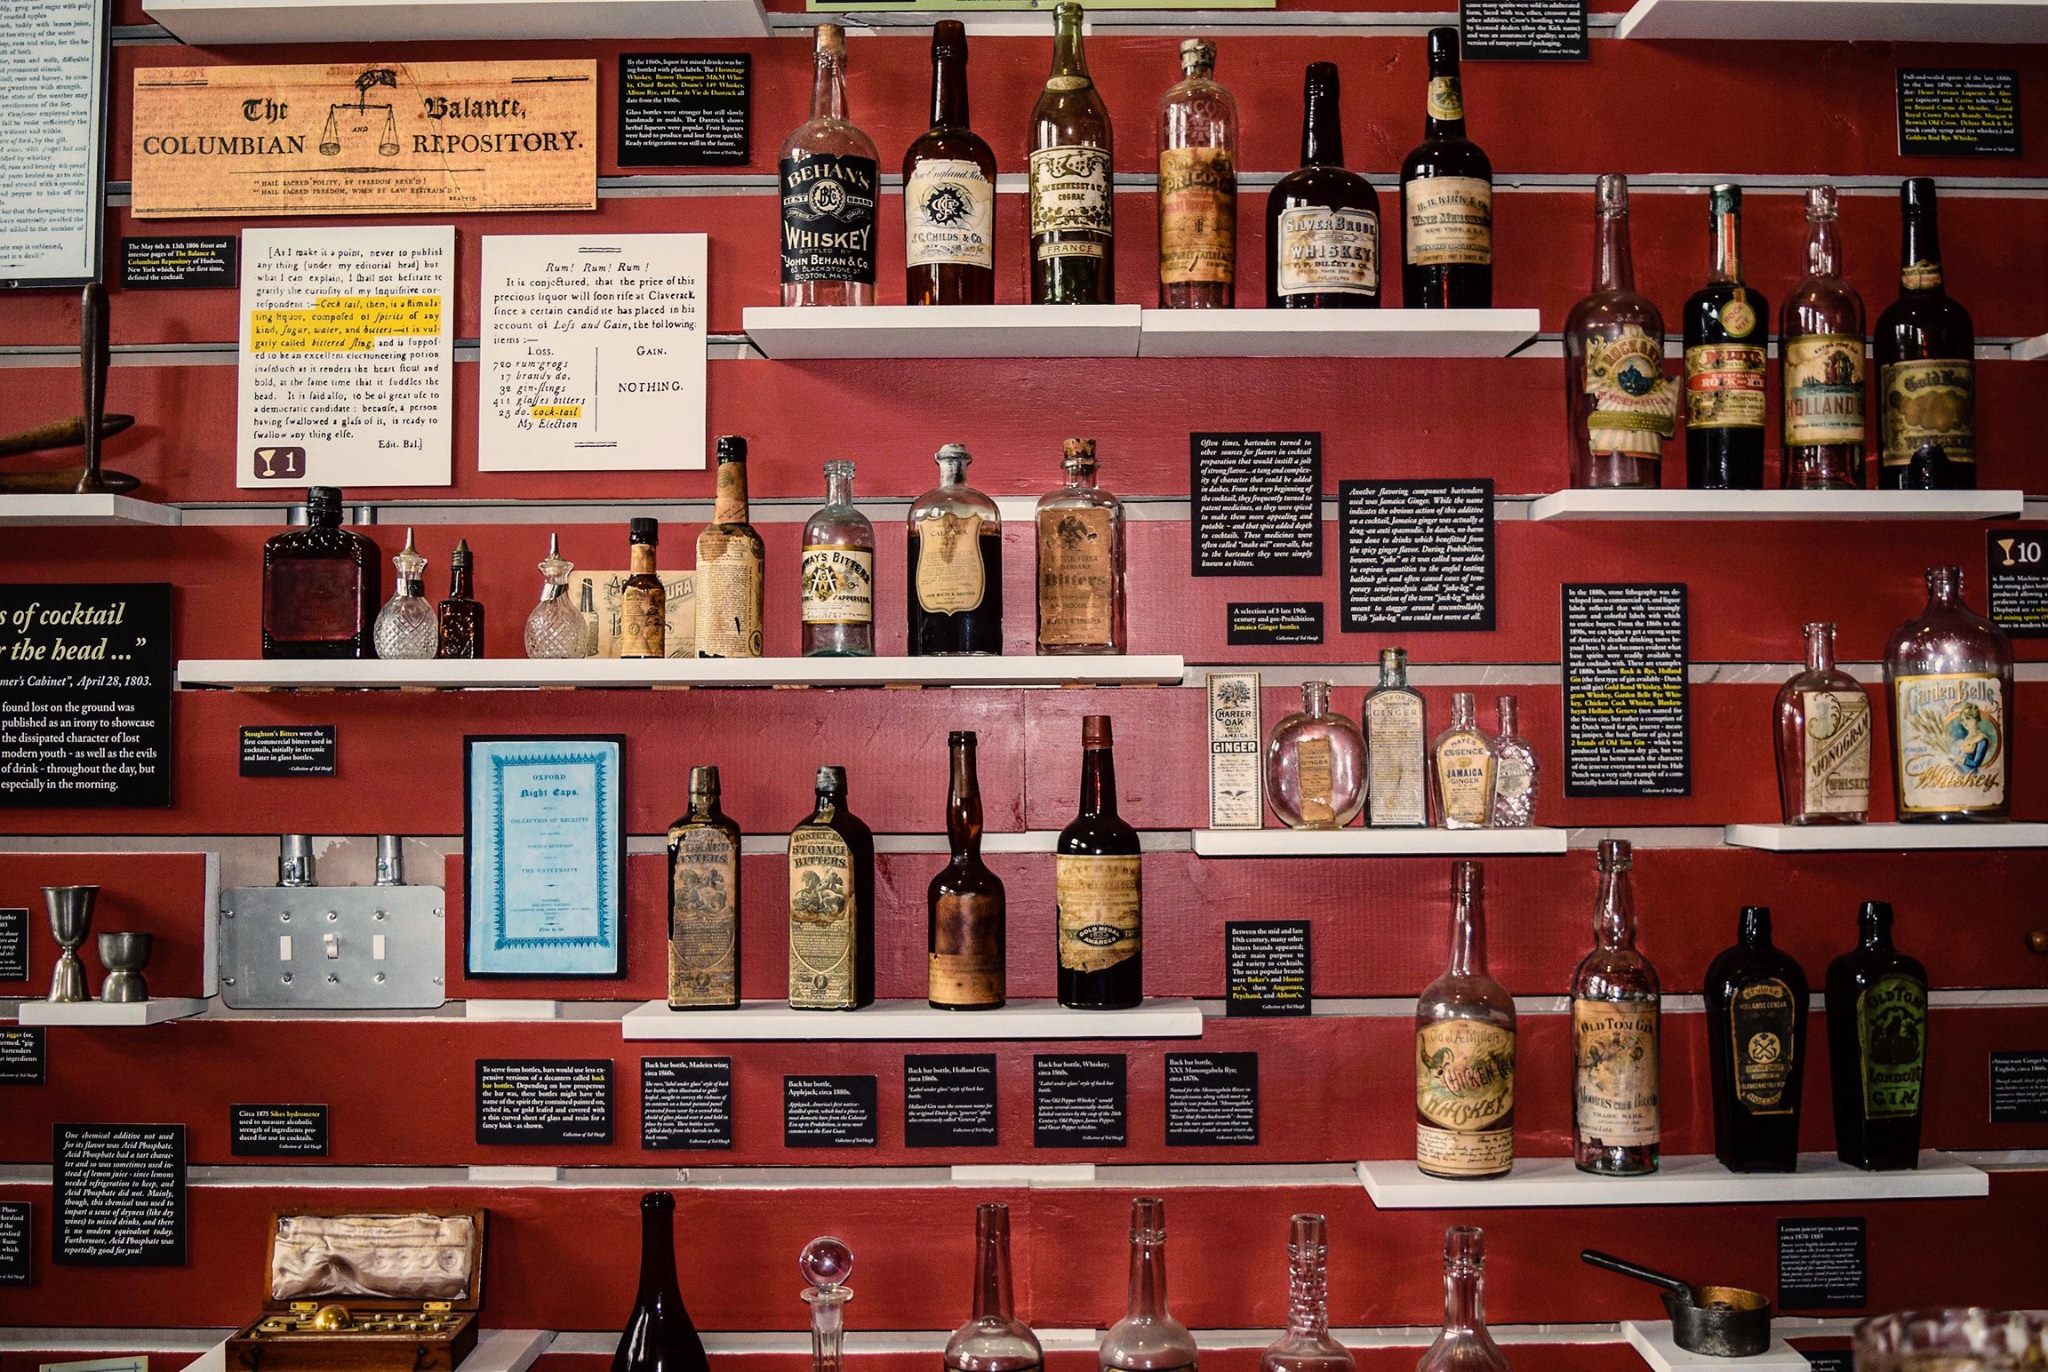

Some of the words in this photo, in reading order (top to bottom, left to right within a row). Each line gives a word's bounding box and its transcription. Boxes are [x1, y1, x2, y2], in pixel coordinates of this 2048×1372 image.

[241, 97, 289, 124] The
[425, 97, 526, 122] Balance,
[143, 135, 306, 157] COLUMBIAN
[352, 126, 369, 134] AND
[412, 132, 584, 154] REPOSITORY.
[788, 163, 870, 191] BEHAN'S
[1058, 192, 1085, 202] COGNAC
[1286, 218, 1334, 233] SILVER
[784, 221, 871, 251] WHISKEY
[926, 233, 959, 242] CHILDS
[1048, 244, 1094, 254] FRANCE
[1291, 246, 1372, 262] WHISKEY
[811, 254, 846, 266] BEHAN
[618, 381, 684, 393] NOTHING.
[533, 407, 578, 417] cock-tail
[518, 419, 534, 430] My
[1200, 439, 1219, 448] Often
[286, 452, 296, 472] 1
[2018, 542, 2042, 562] 10
[833, 552, 870, 585] BITTERS
[12, 602, 39, 633] of
[40, 602, 125, 626] cocktail
[1270, 615, 1315, 624] pre-Prohibition
[1258, 624, 1278, 632] Ginger
[11, 638, 46, 661] the
[51, 638, 108, 661] head
[76, 675, 106, 689] April
[106, 675, 123, 688] 28,
[125, 675, 152, 687] 1803.
[1956, 681, 1995, 704] Belle
[2, 702, 29, 712] found
[32, 702, 48, 712] lost
[65, 702, 79, 712] the
[82, 701, 115, 715] ground
[1216, 708, 1252, 721] CHARTER
[1373, 708, 1417, 717] GINGER
[2, 717, 46, 730] published
[74, 718, 98, 730] irony
[112, 717, 154, 727] showcase
[1224, 718, 1244, 727] OAK
[2, 732, 16, 743] the
[18, 732, 64, 745] dissipated
[66, 732, 110, 743] character
[111, 732, 122, 743] of
[120, 732, 140, 743] lost
[1213, 742, 1256, 752] GINGER
[1444, 748, 1484, 757] ESSENCE
[532, 774, 567, 782] OXFORD
[1447, 768, 1483, 778] JAMAICA
[1917, 762, 2000, 792] Whiskey
[1080, 926, 1098, 937] GOLD
[1607, 1017, 1633, 1030] TOM
[1872, 1090, 1918, 1106] GIN
[113, 1132, 141, 1140] additive
